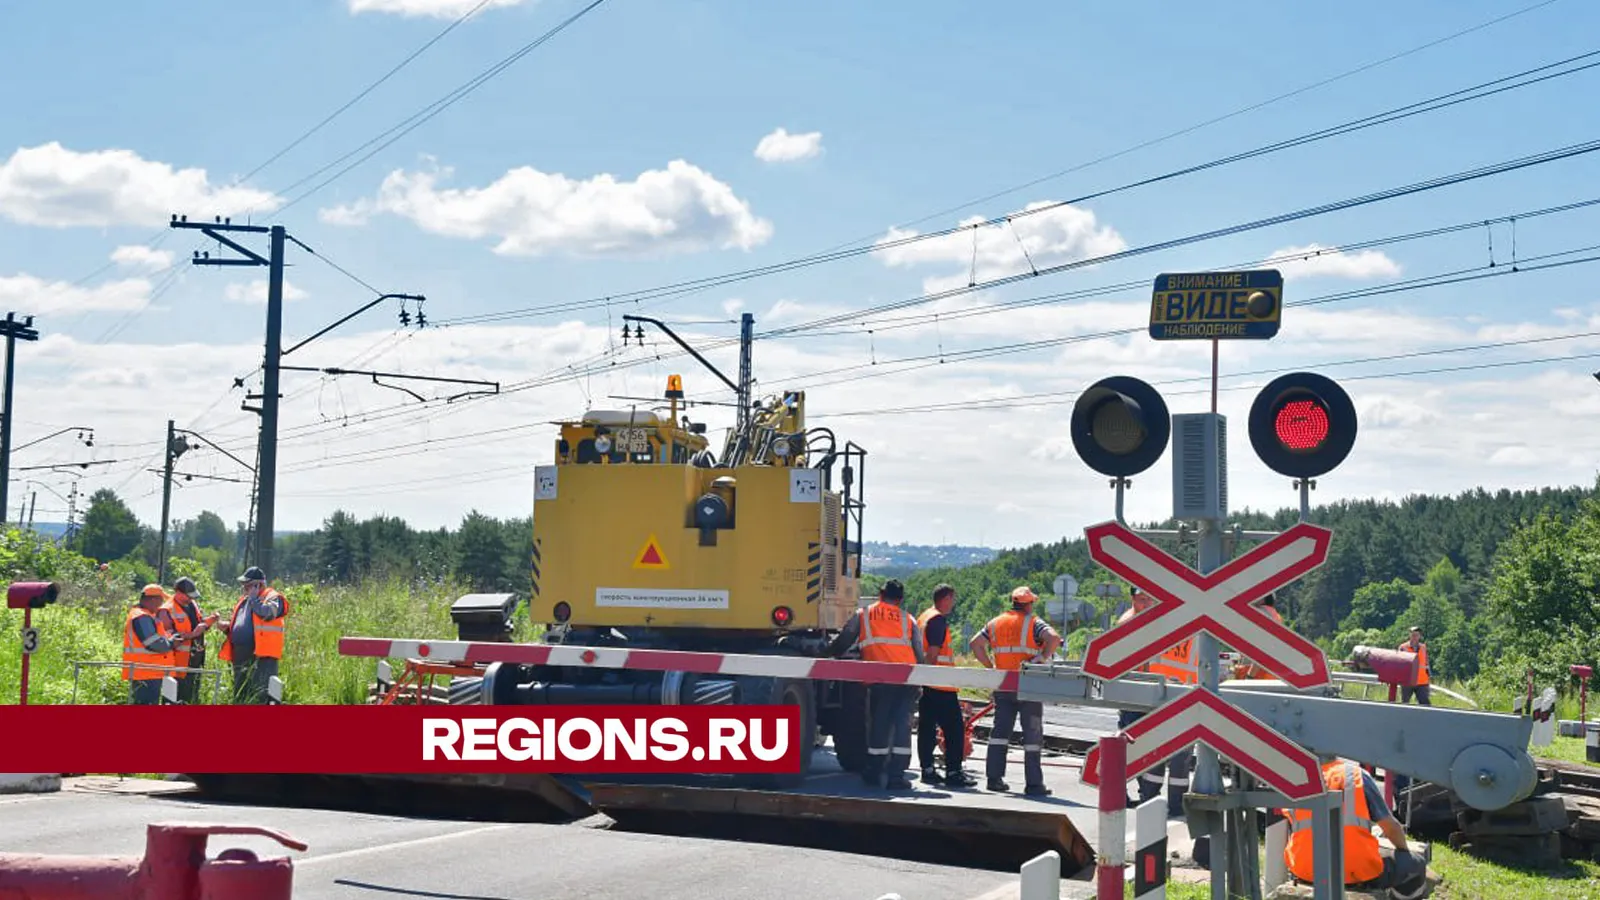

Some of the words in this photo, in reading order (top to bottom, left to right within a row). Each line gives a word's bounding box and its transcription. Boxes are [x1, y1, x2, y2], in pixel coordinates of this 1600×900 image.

[1168, 274, 1242, 288] ВНИМАНИЕ
[1164, 323, 1247, 337] НАБЛЮДЕНИЕ
[25, 631, 36, 651] 3
